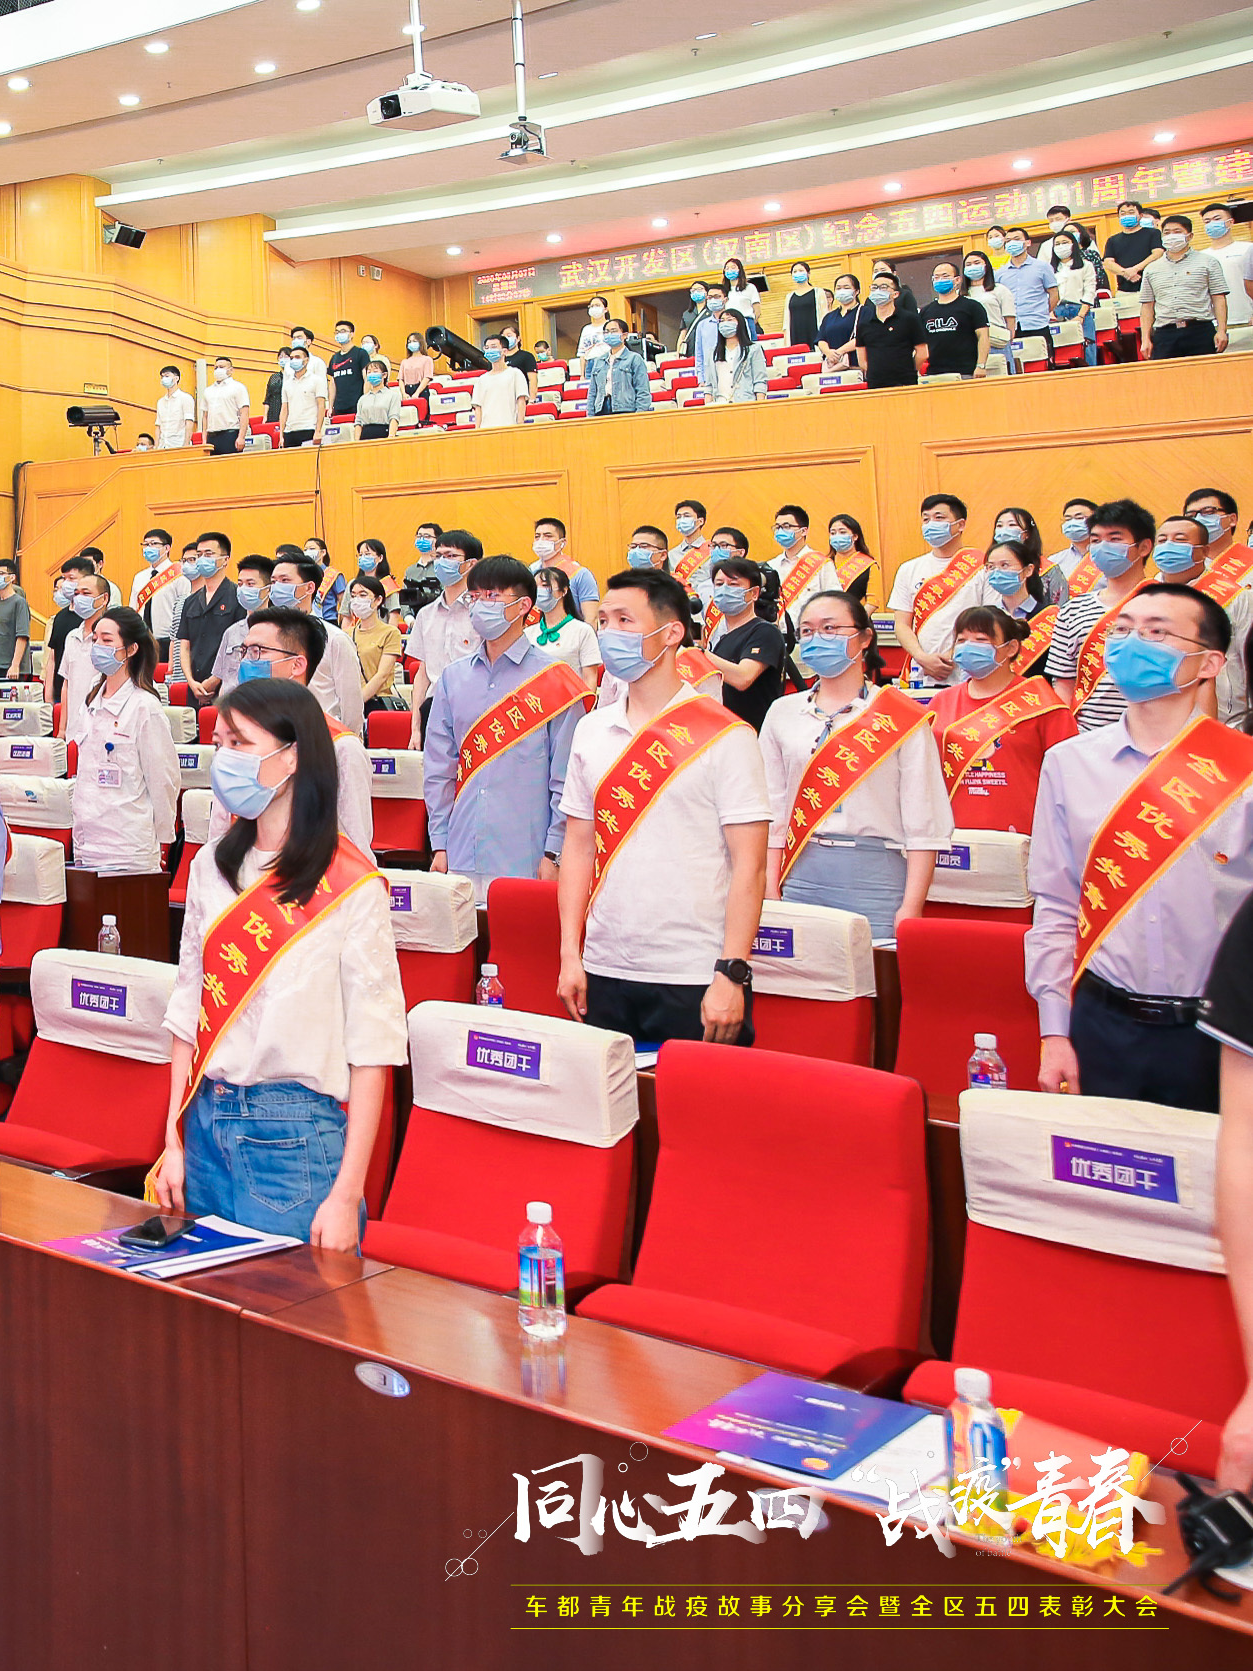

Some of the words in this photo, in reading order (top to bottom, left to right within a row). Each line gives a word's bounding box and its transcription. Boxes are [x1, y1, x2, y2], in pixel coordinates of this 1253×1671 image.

[926, 316, 958, 331] FILA
[79, 991, 120, 1011] 优秀团干
[476, 1046, 532, 1072] 优秀团干
[1070, 1156, 1160, 1191] 优秀团干
